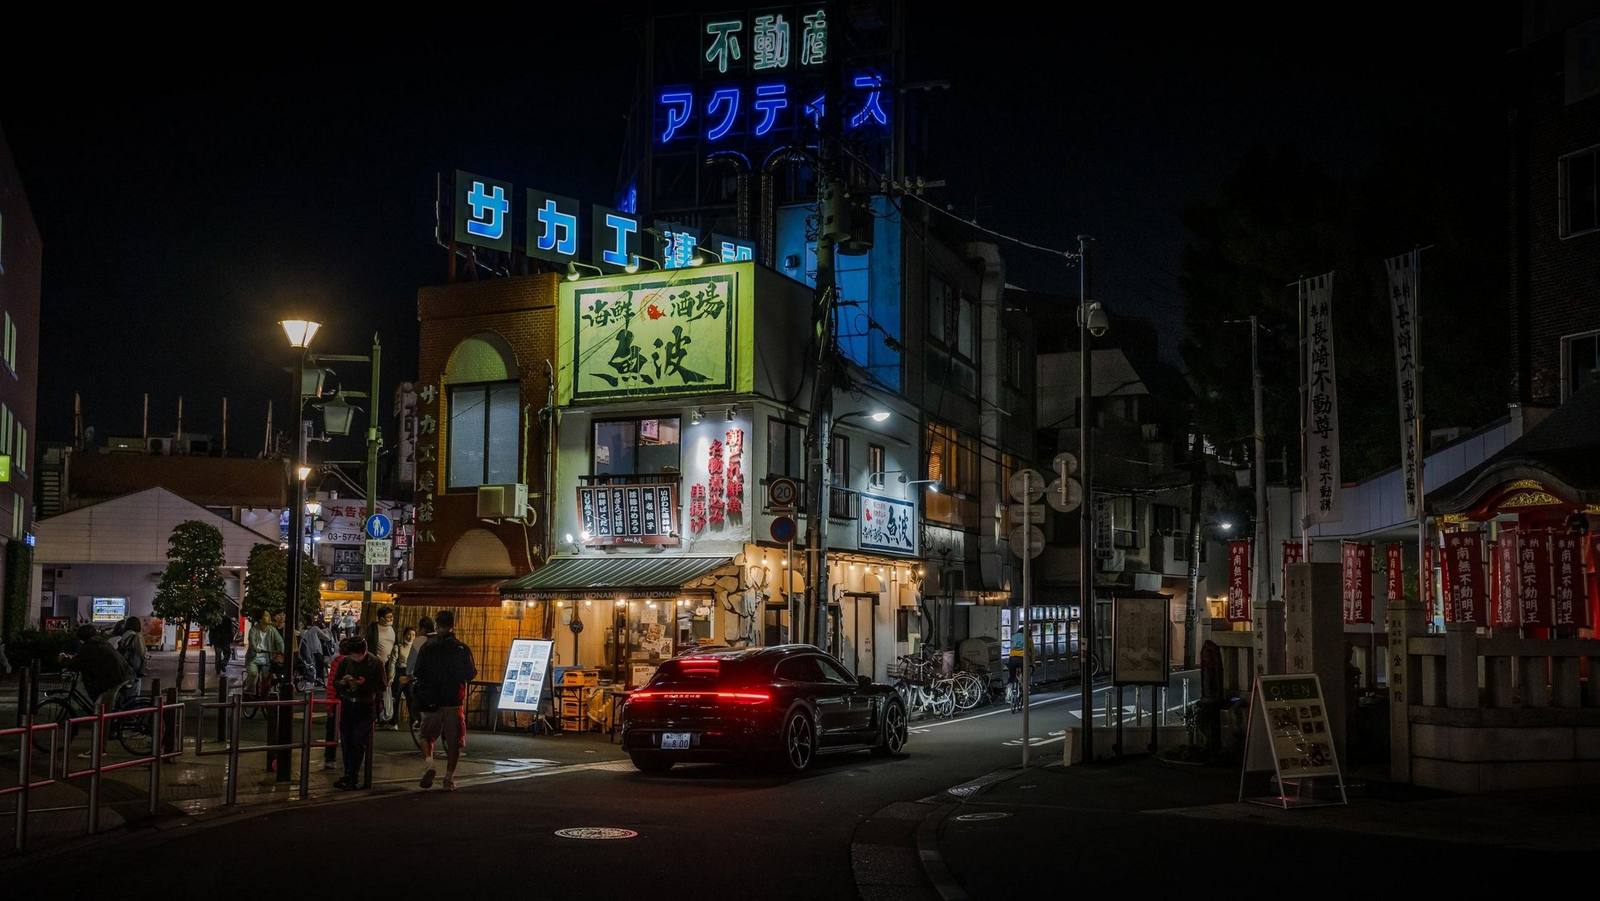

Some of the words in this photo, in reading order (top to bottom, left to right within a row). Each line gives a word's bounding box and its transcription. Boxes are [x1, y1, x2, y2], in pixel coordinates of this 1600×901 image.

[706, 9, 827, 73] 不動産
[582, 289, 636, 331] 海鮮
[669, 282, 726, 323] 酒場
[588, 324, 714, 387] 魚波
[1312, 321, 1333, 438] 長崎不動尊
[690, 483, 707, 535] 串揚げ
[709, 438, 725, 525] 名物煮込み
[776, 486, 791, 499] 20
[1456, 547, 1477, 624] 南無不動明王
[1522, 549, 1541, 624] 南無不動明王
[1270, 683, 1314, 698] OPEN
